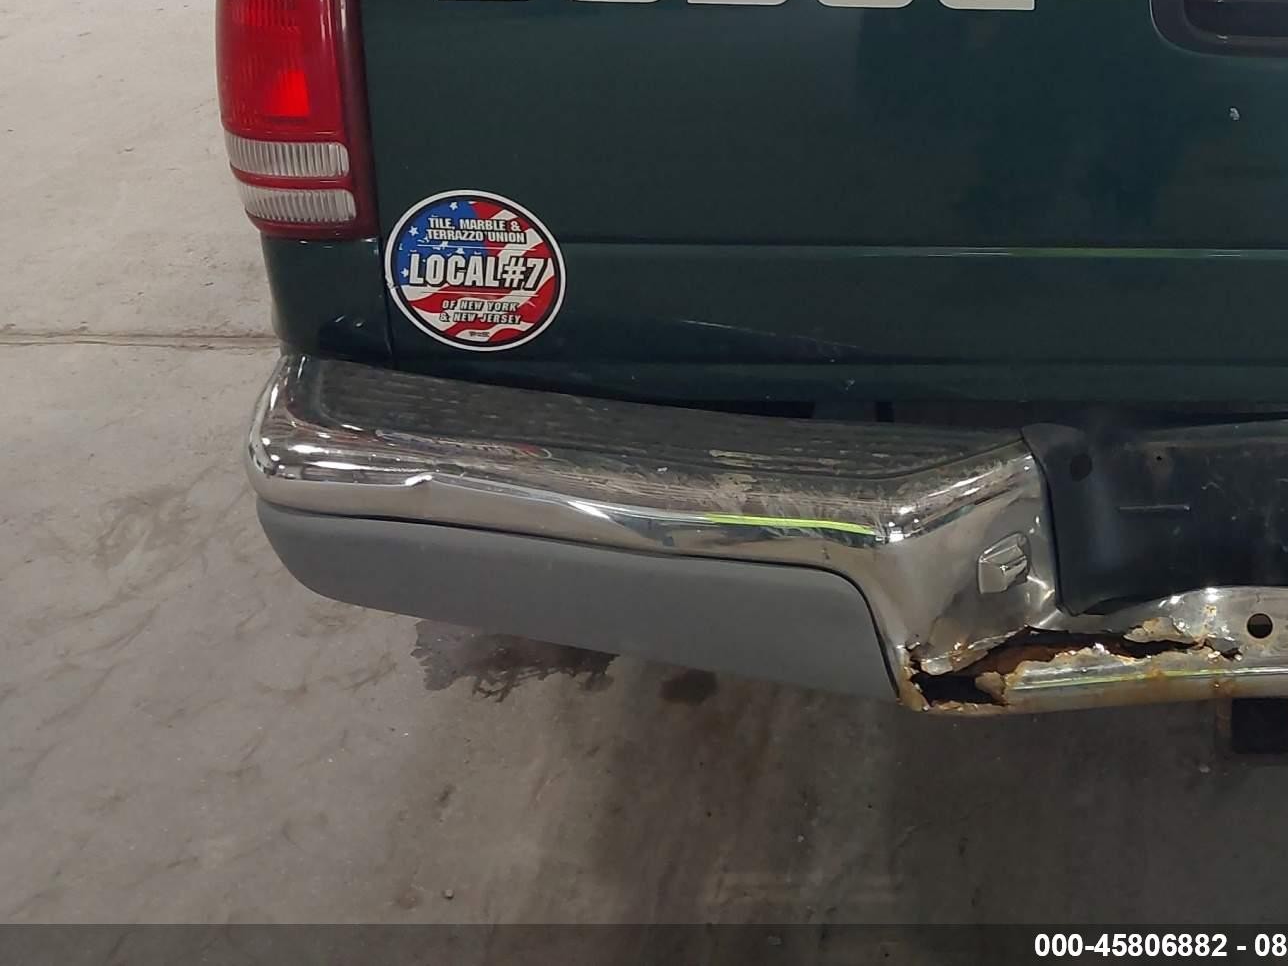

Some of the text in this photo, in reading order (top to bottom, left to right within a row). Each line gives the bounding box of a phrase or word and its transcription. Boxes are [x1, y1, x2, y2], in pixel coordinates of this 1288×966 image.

[428, 218, 521, 232] TILE, MARBLE &
[426, 229, 525, 243] TERRAZZO UNION
[442, 299, 518, 312] OF NEW YORK
[439, 312, 522, 324] & NEW JERSEY
